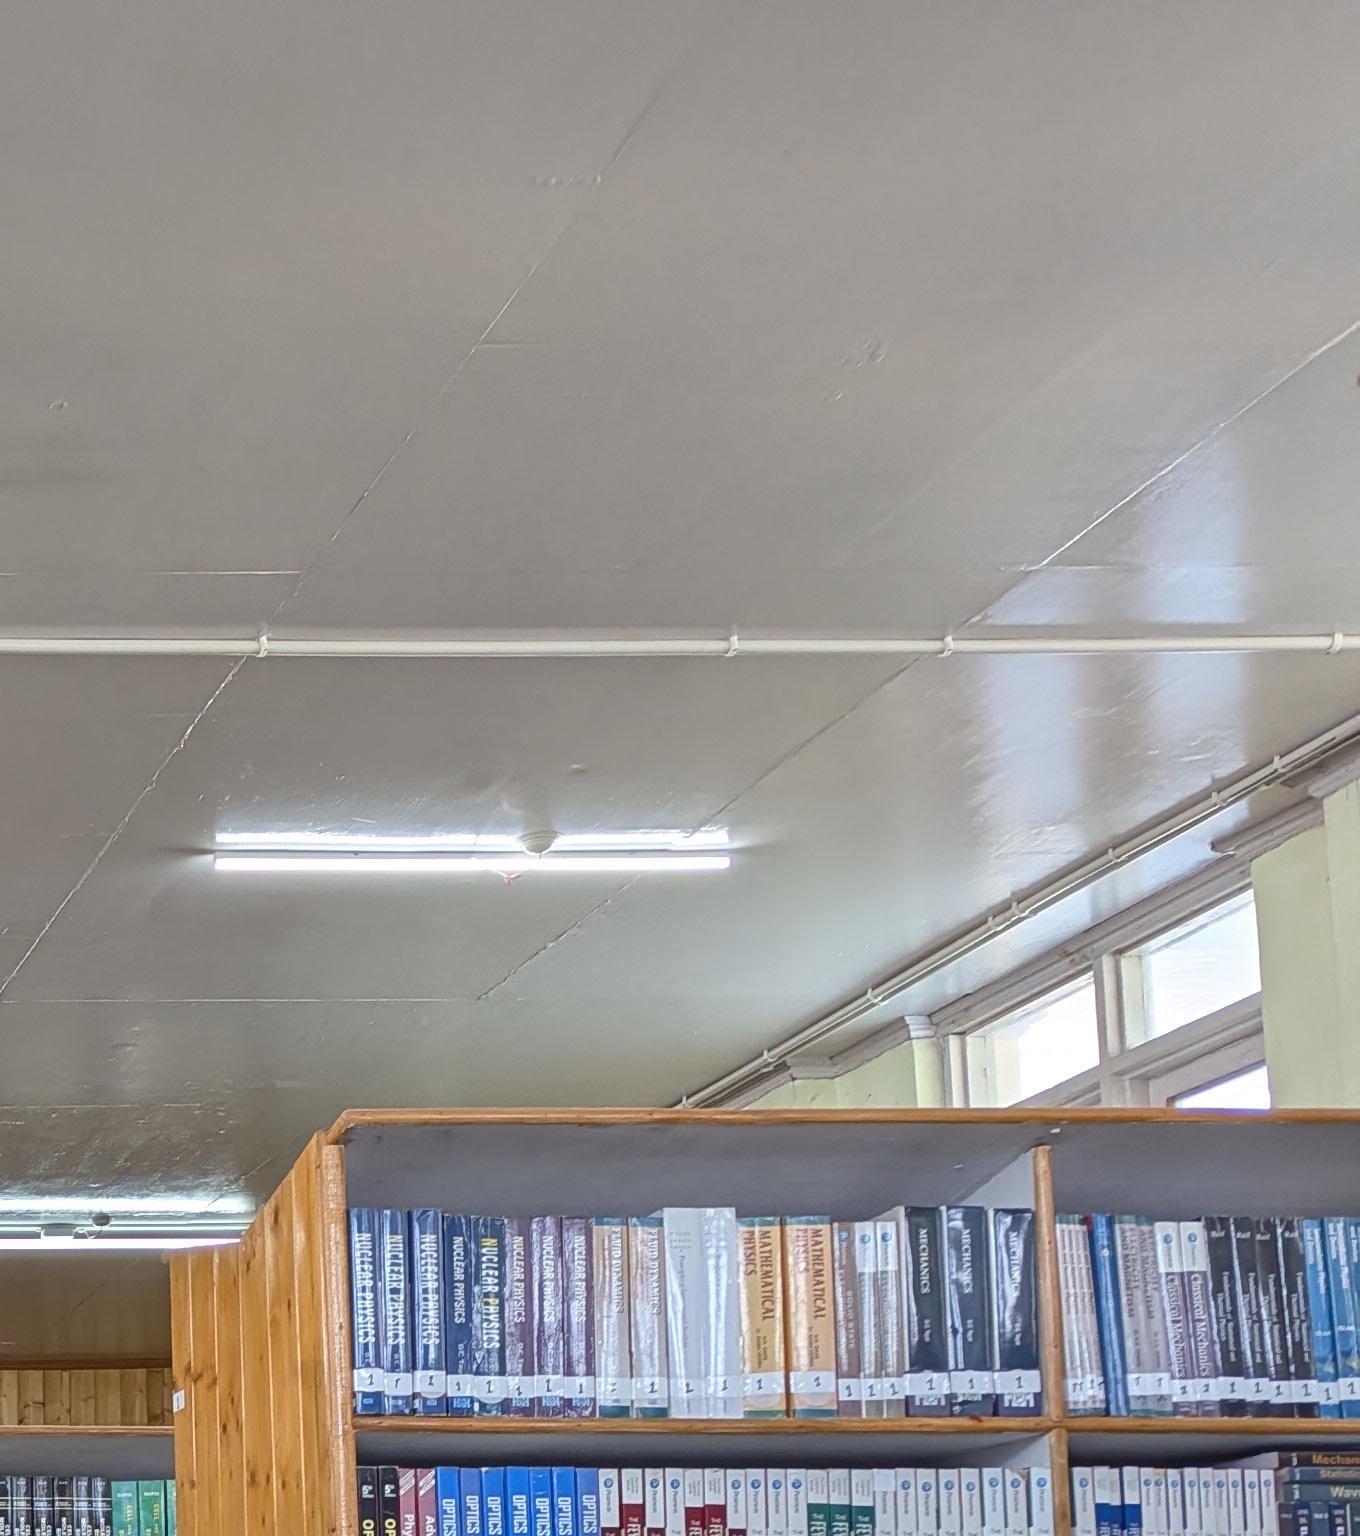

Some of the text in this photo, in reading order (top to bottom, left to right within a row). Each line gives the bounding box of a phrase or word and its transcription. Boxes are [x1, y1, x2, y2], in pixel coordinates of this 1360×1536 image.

[453, 1236, 465, 1324] NUCLEAR PHYSICS
[742, 1230, 758, 1276] PHYSICS
[759, 1230, 775, 1322] MATHEMATICAL
[811, 1228, 826, 1320] MATHEMATICAL
[919, 1228, 929, 1294] MECHANICS
[962, 1228, 973, 1294] MECHANICS
[356, 1233, 375, 1344] NUCLEAR PHYSICS
[481, 1238, 500, 1349] NUCLEAR PHYSICS
[443, 1499, 456, 1536] OPTICS
[466, 1495, 480, 1534] OPTICS
[513, 1495, 528, 1534] OPTICS
